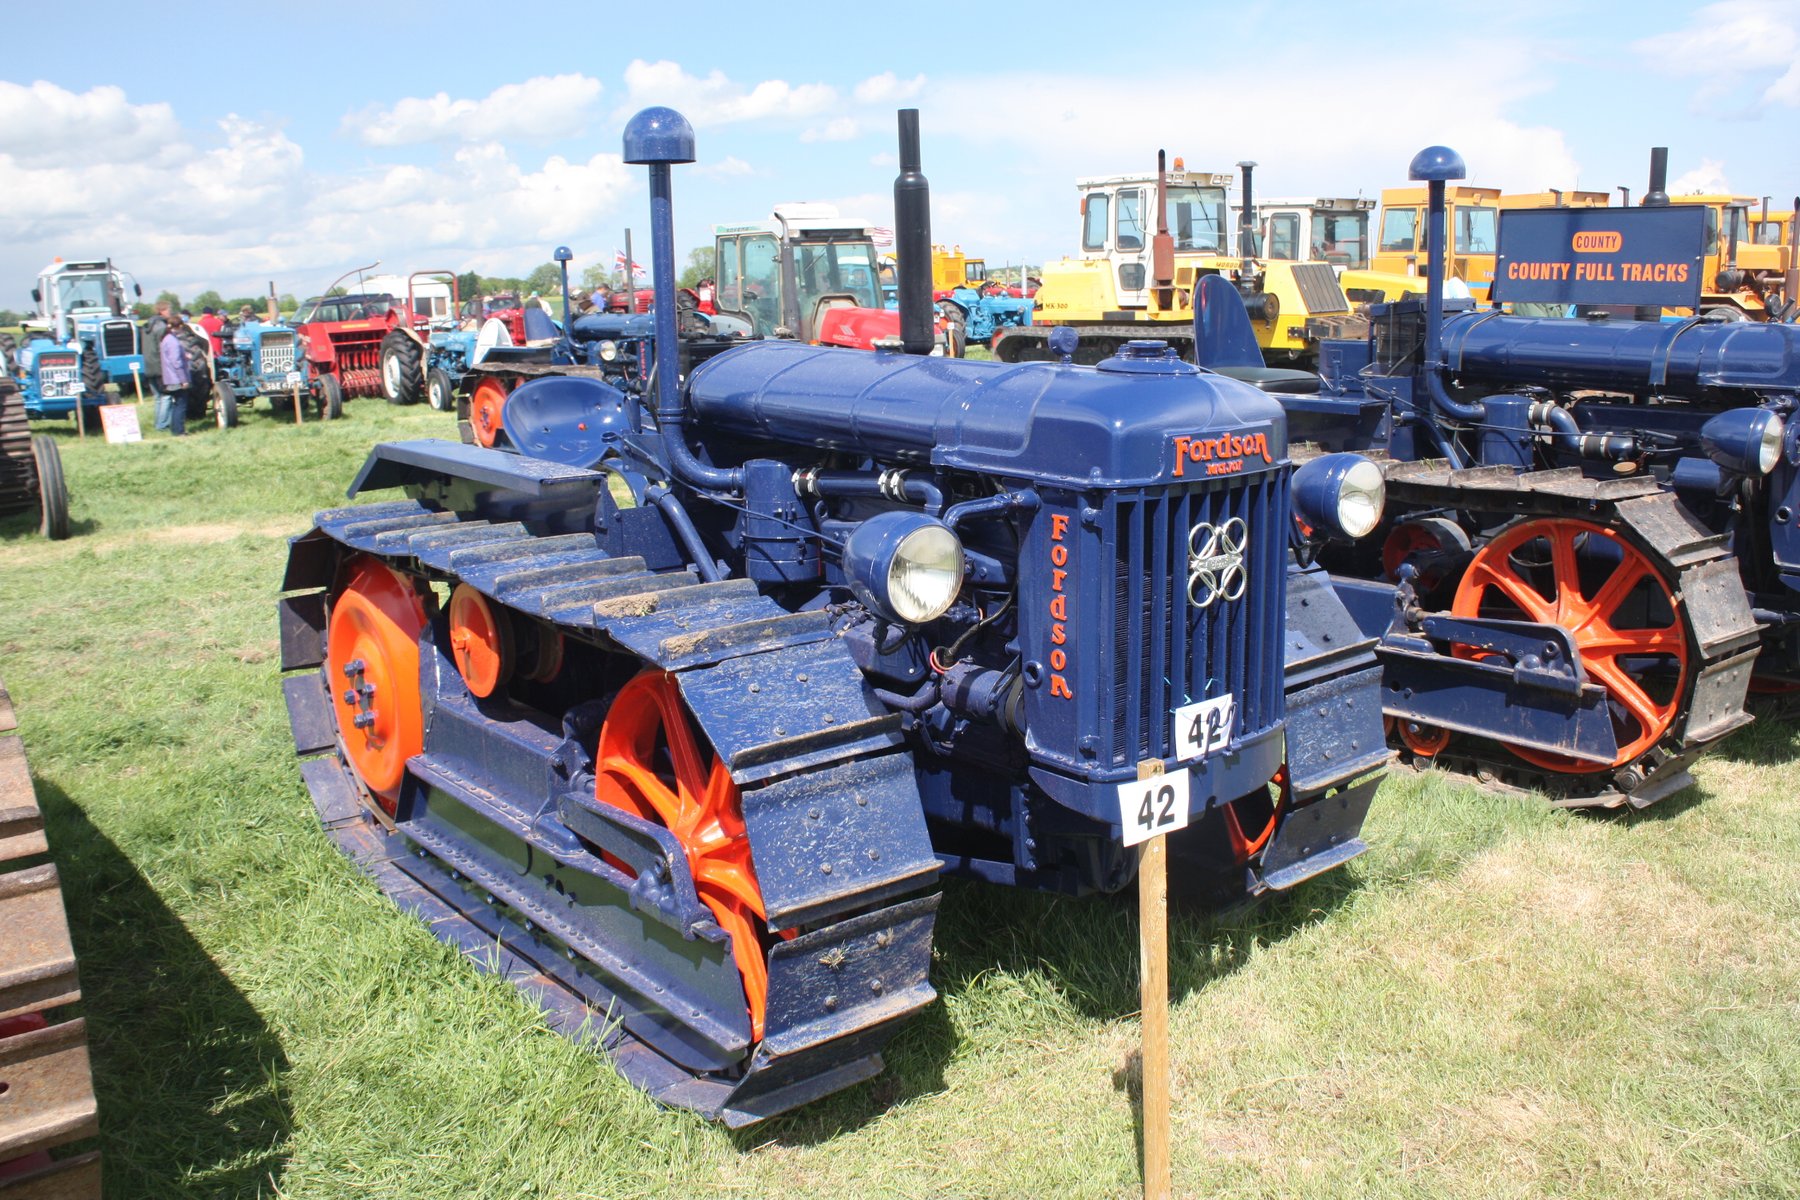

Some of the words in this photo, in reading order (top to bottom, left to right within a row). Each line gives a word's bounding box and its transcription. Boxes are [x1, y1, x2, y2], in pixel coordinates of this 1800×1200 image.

[1576, 235, 1618, 249] COUNTY
[1508, 262, 1571, 281] COUNTY
[1575, 263, 1615, 281] FULL
[1621, 263, 1688, 282] TRACKS
[1173, 432, 1272, 477] Fordson
[1050, 514, 1073, 700] Fordson
[1188, 711, 1221, 748] 42
[1137, 784, 1175, 831] 42
